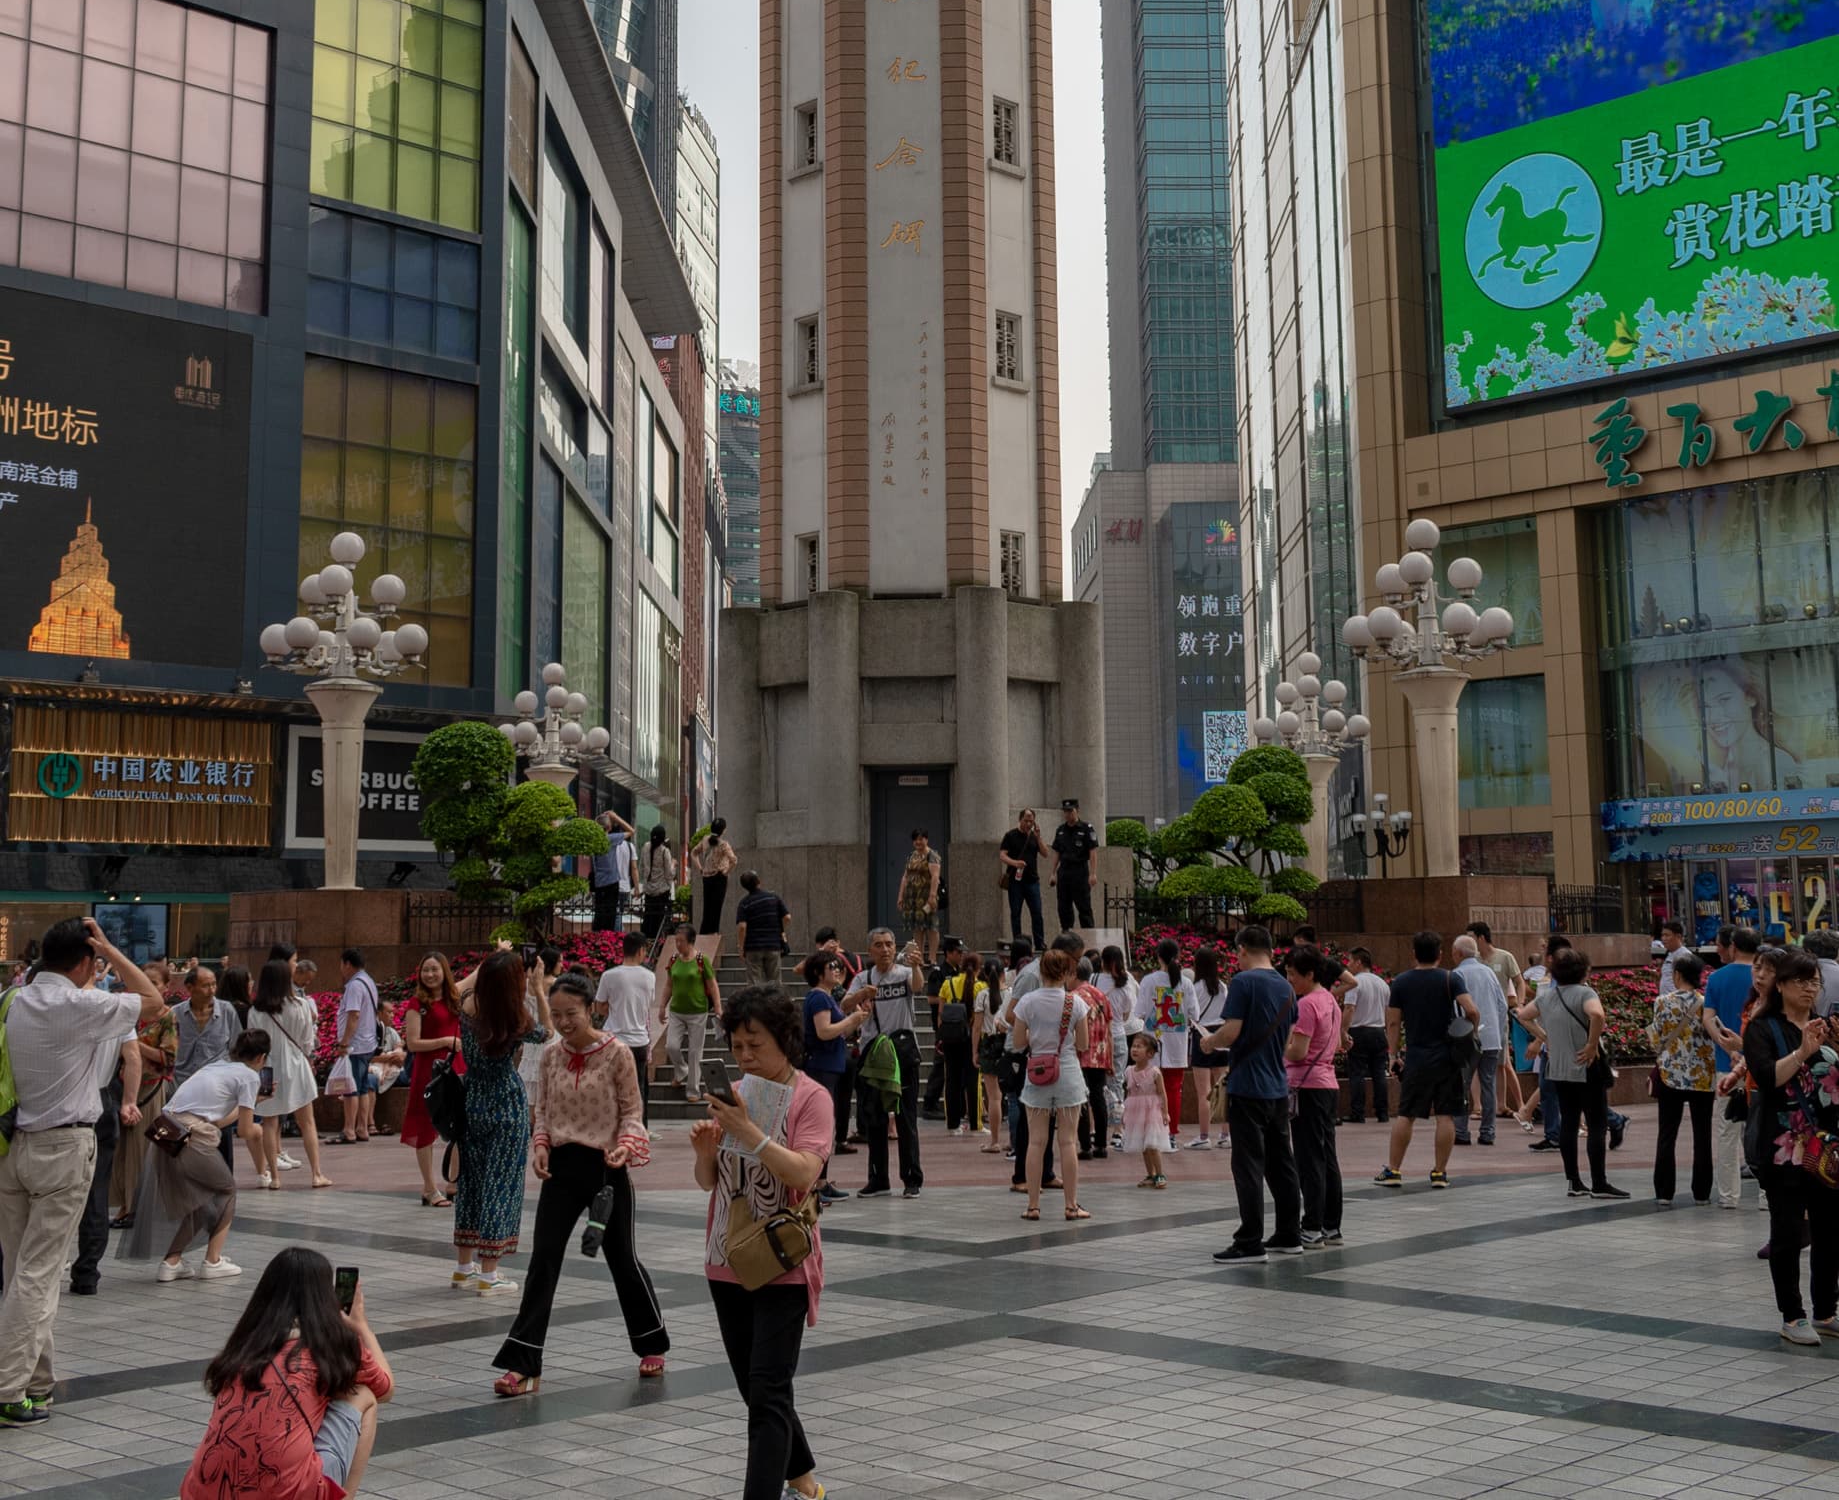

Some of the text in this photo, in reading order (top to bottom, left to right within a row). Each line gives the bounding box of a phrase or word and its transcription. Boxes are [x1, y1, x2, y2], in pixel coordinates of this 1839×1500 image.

[1614, 85, 1839, 196] 最是一年
[1664, 174, 1839, 269] 赏花踏
[0, 460, 79, 490] 南滨金铺
[1177, 631, 1244, 657] 数字户
[93, 755, 254, 788] 中国农业银行
[93, 789, 254, 805] AGRICULTURAL BANK OF CHINA
[359, 792, 420, 812] FFEE
[875, 985, 906, 998] idas
